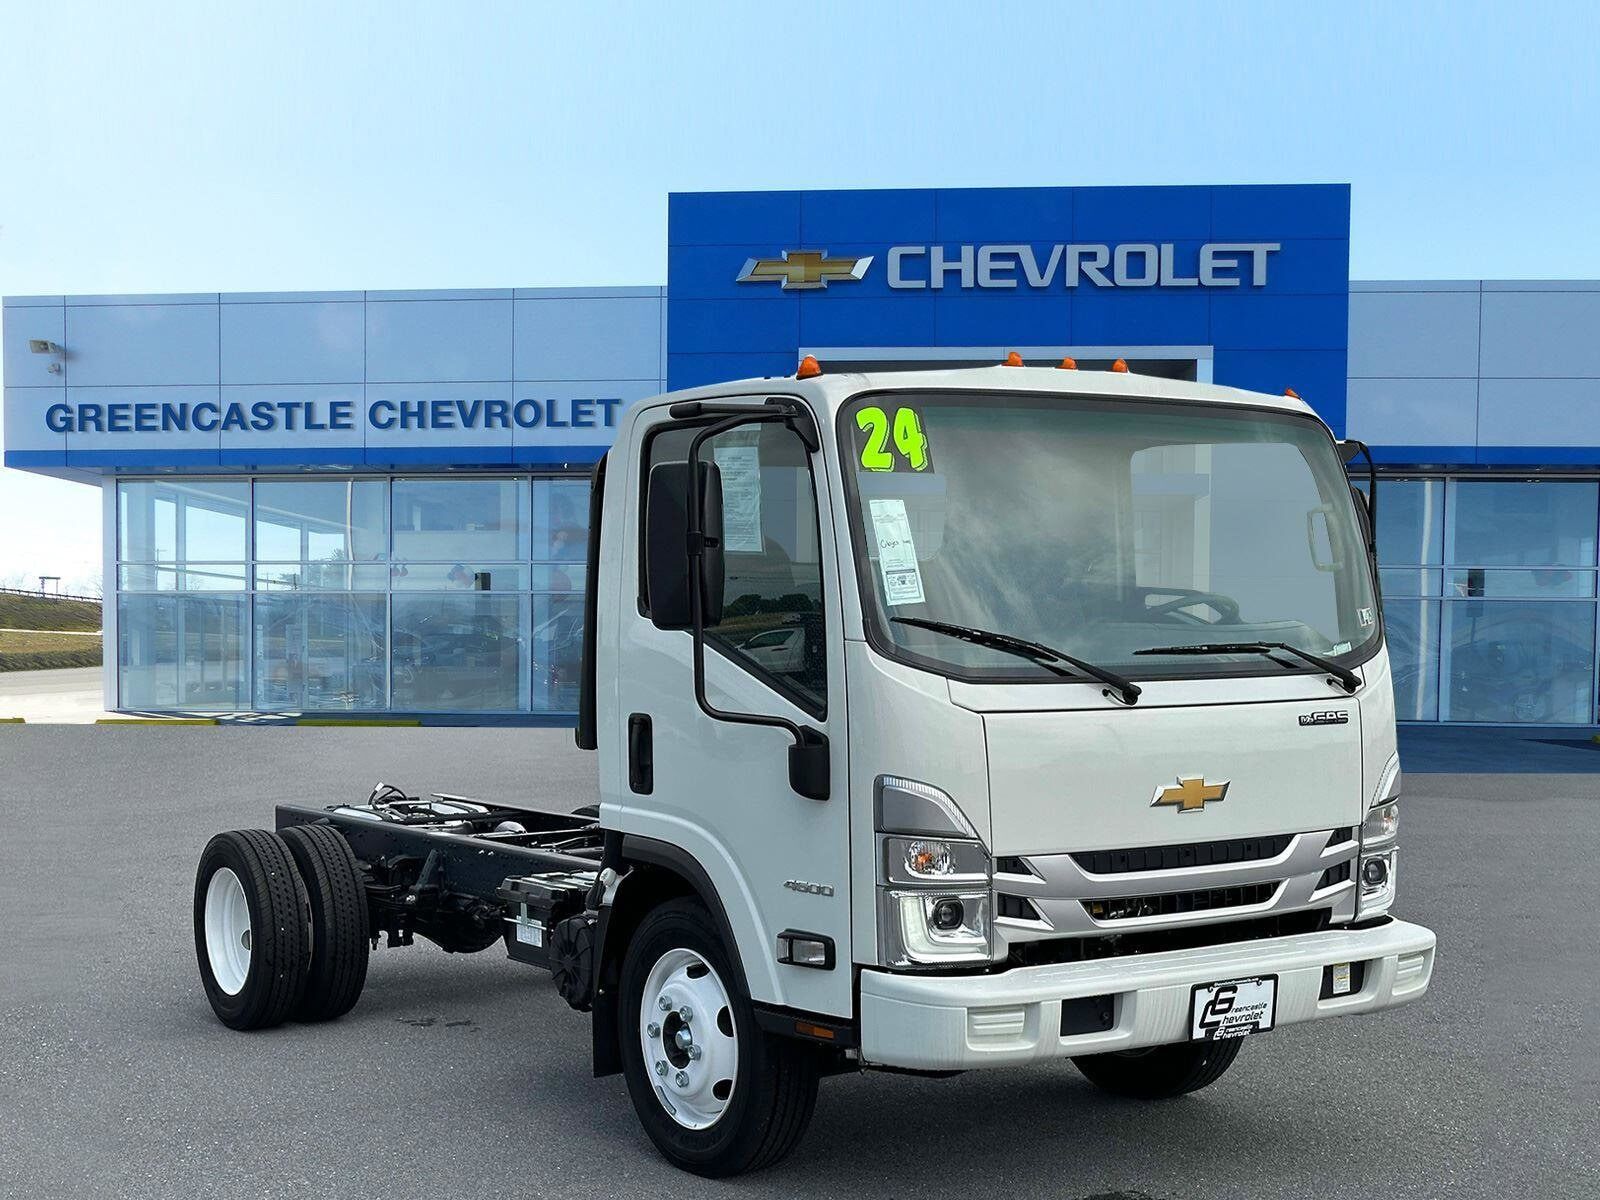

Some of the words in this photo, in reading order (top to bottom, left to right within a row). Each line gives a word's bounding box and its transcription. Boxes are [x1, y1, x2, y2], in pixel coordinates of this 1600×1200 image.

[886, 242, 1281, 290] CHEVROLET
[45, 400, 355, 432] GREENCASTLE
[368, 398, 622, 429] CHEVROLET
[855, 406, 928, 472] 24
[783, 879, 834, 897] 4500
